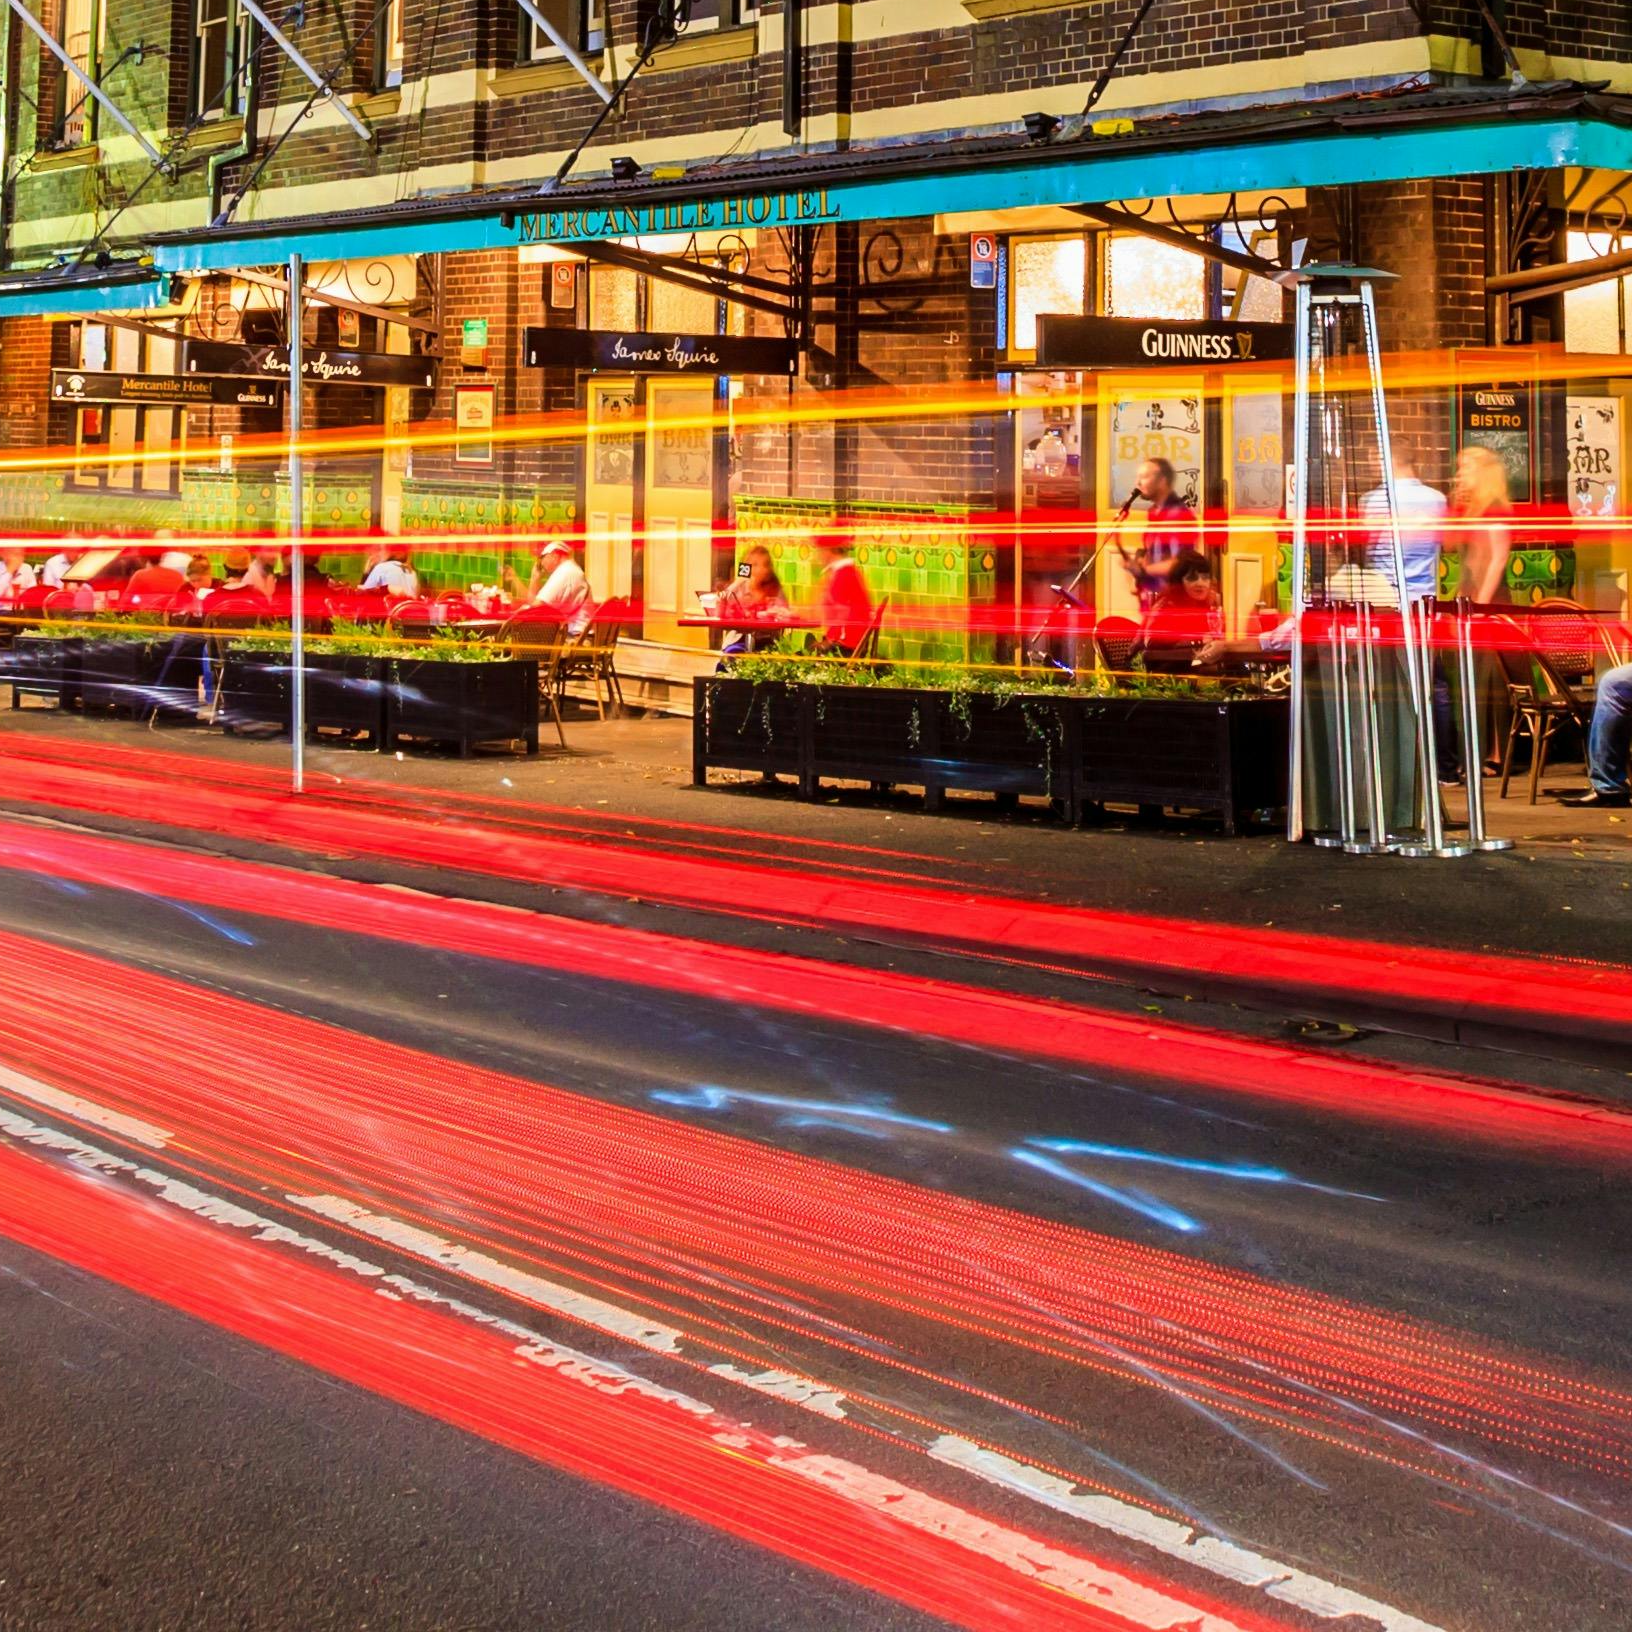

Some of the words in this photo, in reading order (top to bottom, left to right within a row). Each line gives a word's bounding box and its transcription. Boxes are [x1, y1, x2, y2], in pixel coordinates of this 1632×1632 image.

[518, 200, 714, 243] MERCANTILE
[722, 186, 841, 225] HOTEL
[612, 336, 662, 363] James
[665, 336, 719, 369] Squire
[1141, 328, 1233, 359] GUINNESS
[262, 350, 308, 371] Jams
[311, 351, 362, 380] Squire
[121, 377, 181, 392] Mercantile
[182, 380, 213, 393] Hotel
[1471, 414, 1521, 427] BISTRO
[662, 427, 707, 449] BAR
[1118, 435, 1193, 462] BAR
[738, 564, 751, 577] 29
